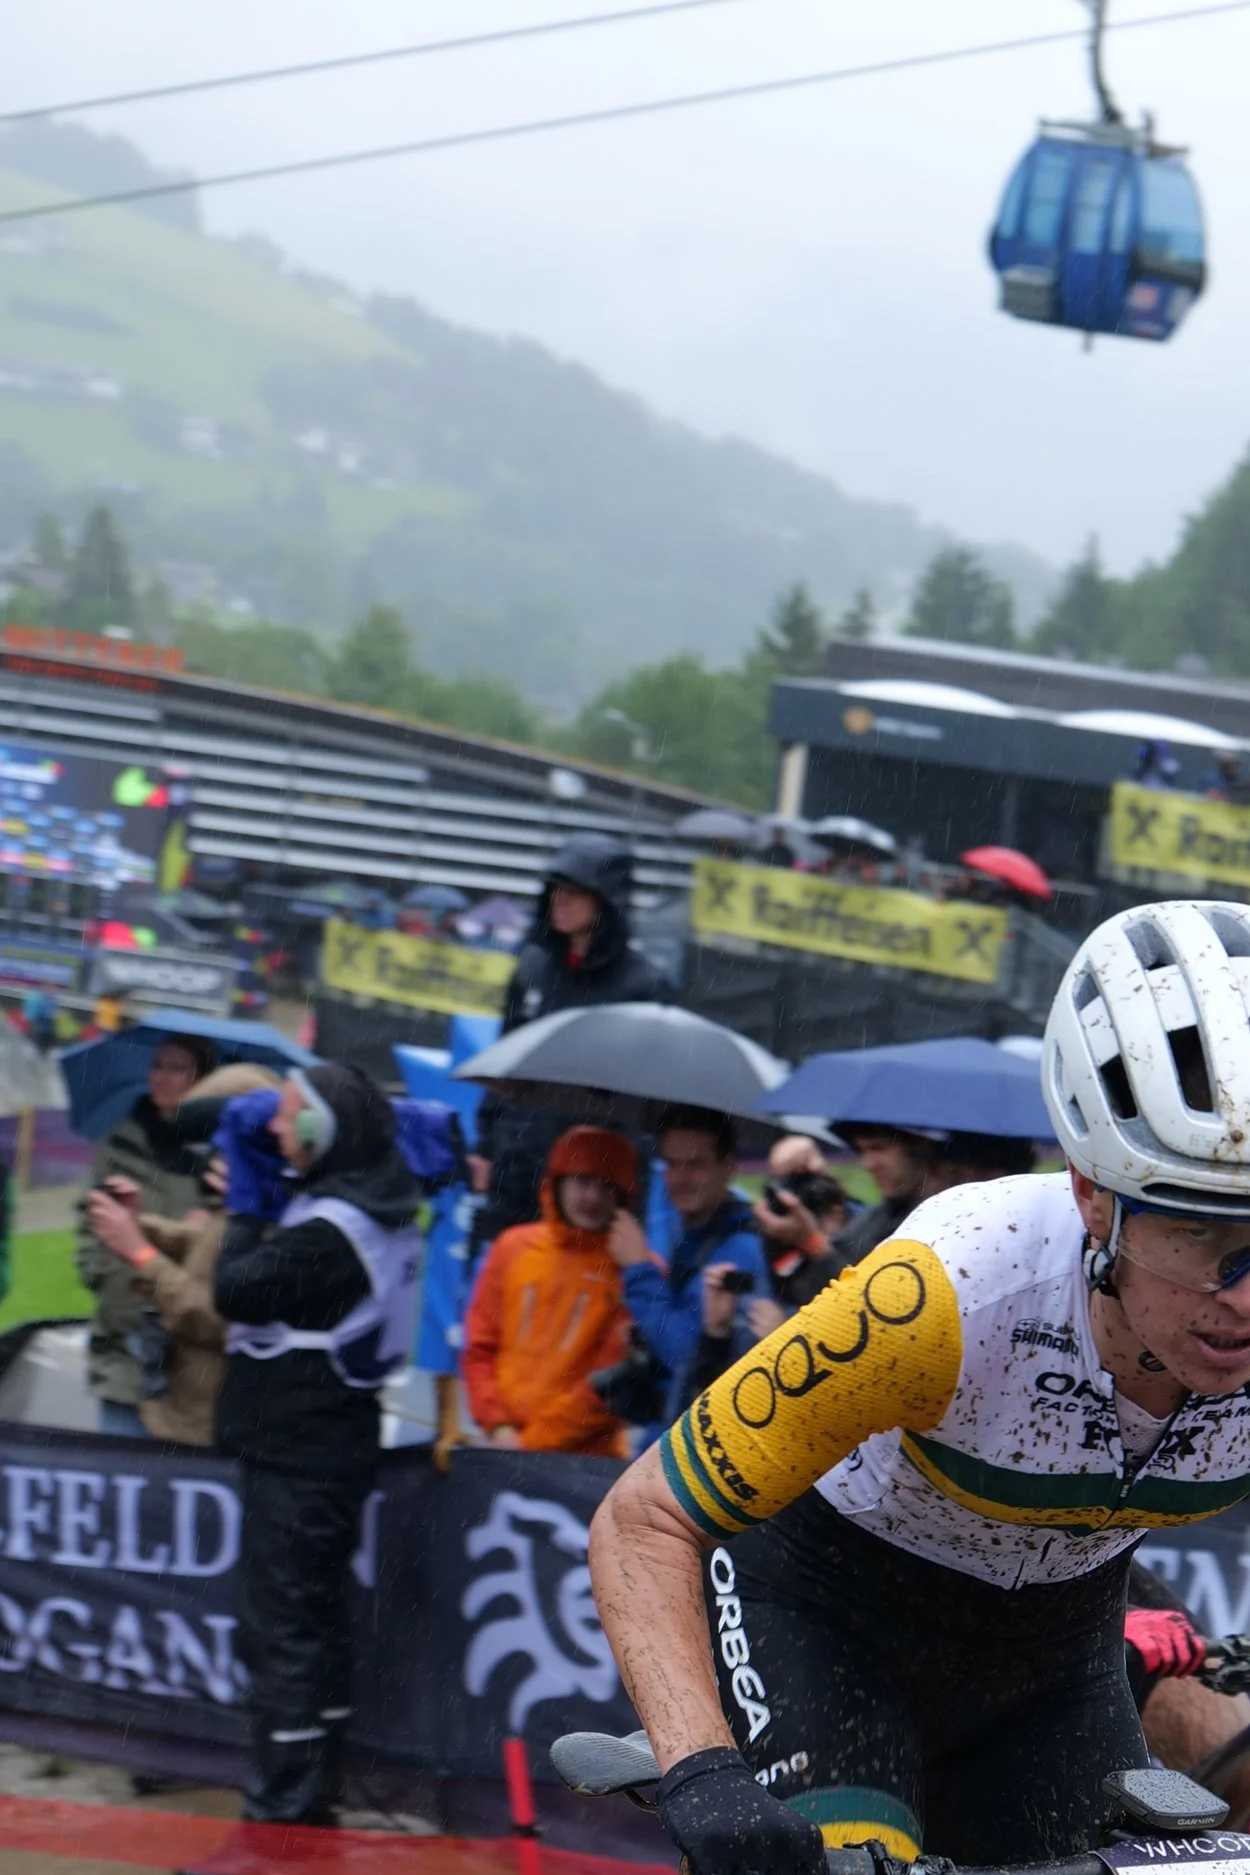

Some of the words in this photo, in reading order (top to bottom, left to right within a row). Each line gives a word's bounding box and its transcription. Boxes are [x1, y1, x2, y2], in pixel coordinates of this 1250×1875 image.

[697, 1391, 761, 1501] MAXXIS
[710, 1546, 772, 1744] ORBEA
[1177, 1817, 1216, 1827] GARMIN
